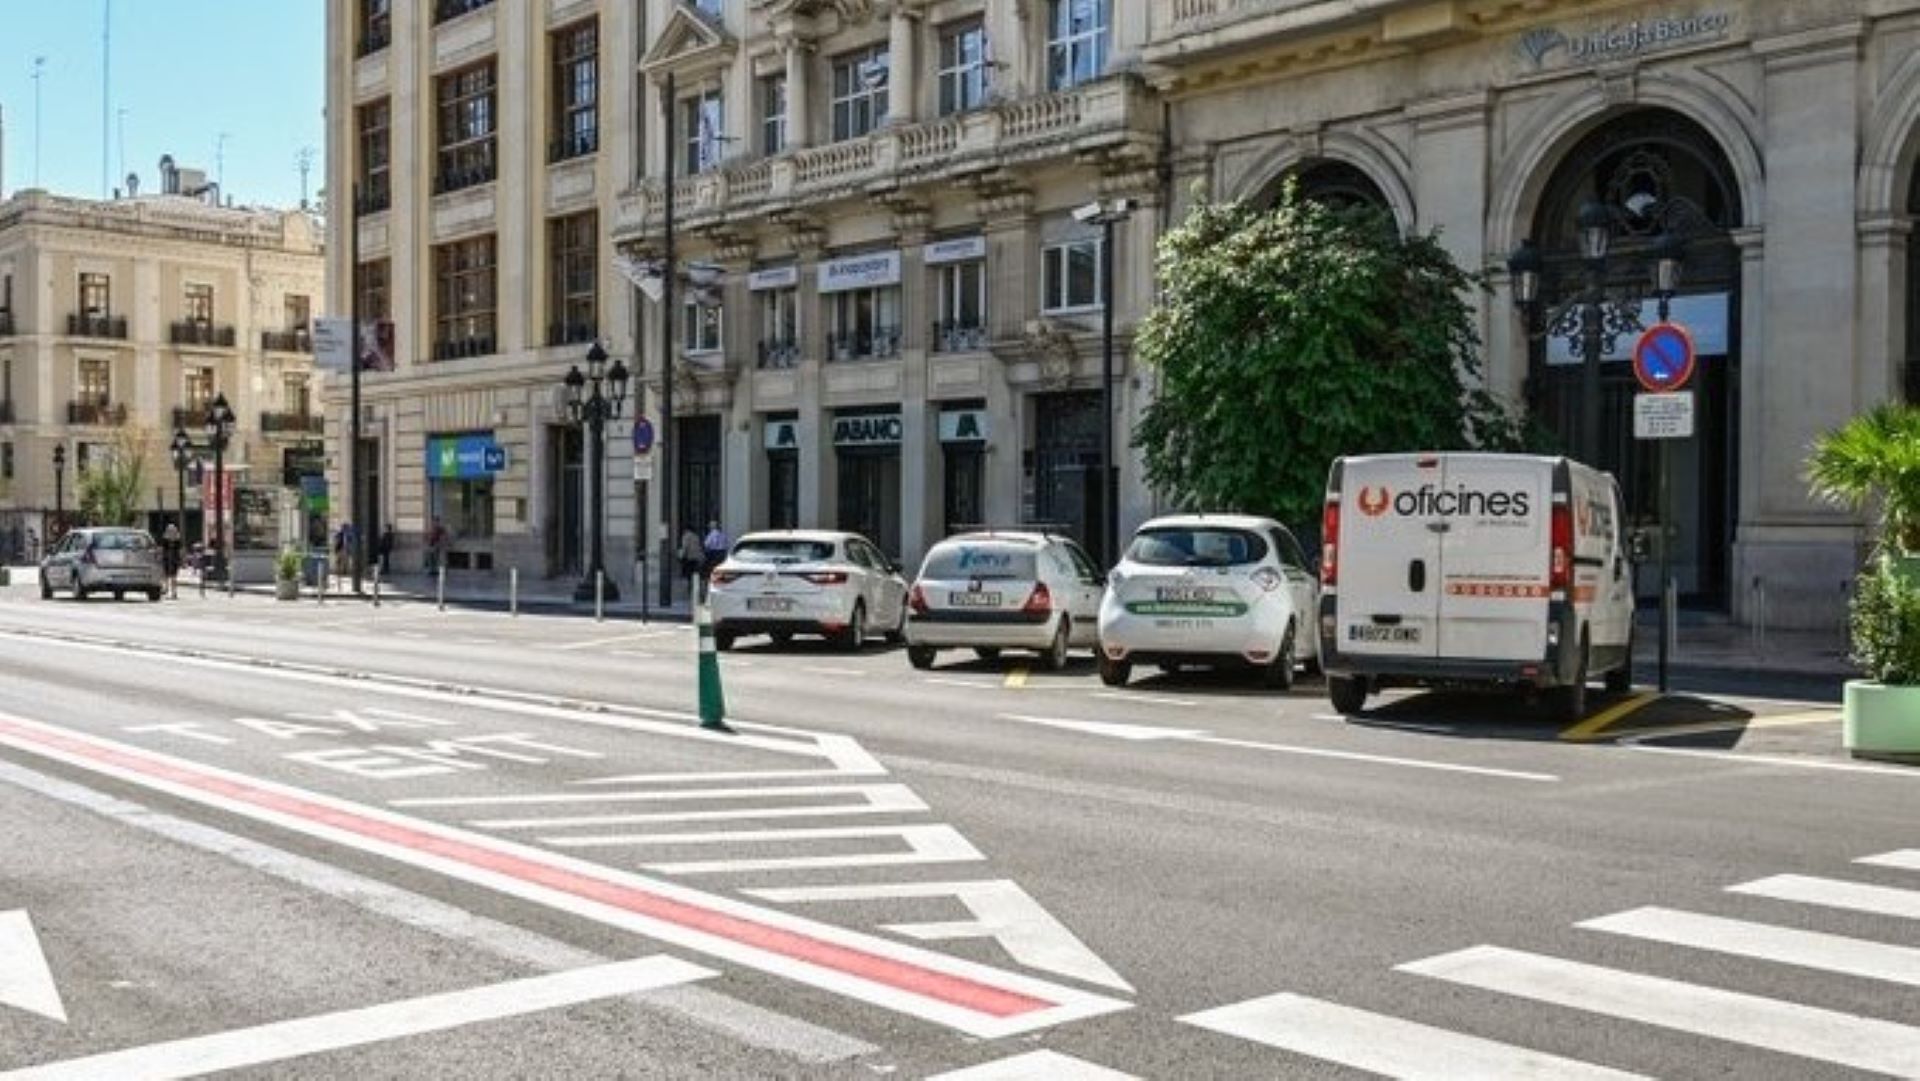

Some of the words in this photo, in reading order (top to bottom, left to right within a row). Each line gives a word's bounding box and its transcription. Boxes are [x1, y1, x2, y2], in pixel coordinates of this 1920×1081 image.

[837, 417, 902, 441] ABANC
[1394, 484, 1530, 517] oficines
[282, 732, 606, 778] EMT
